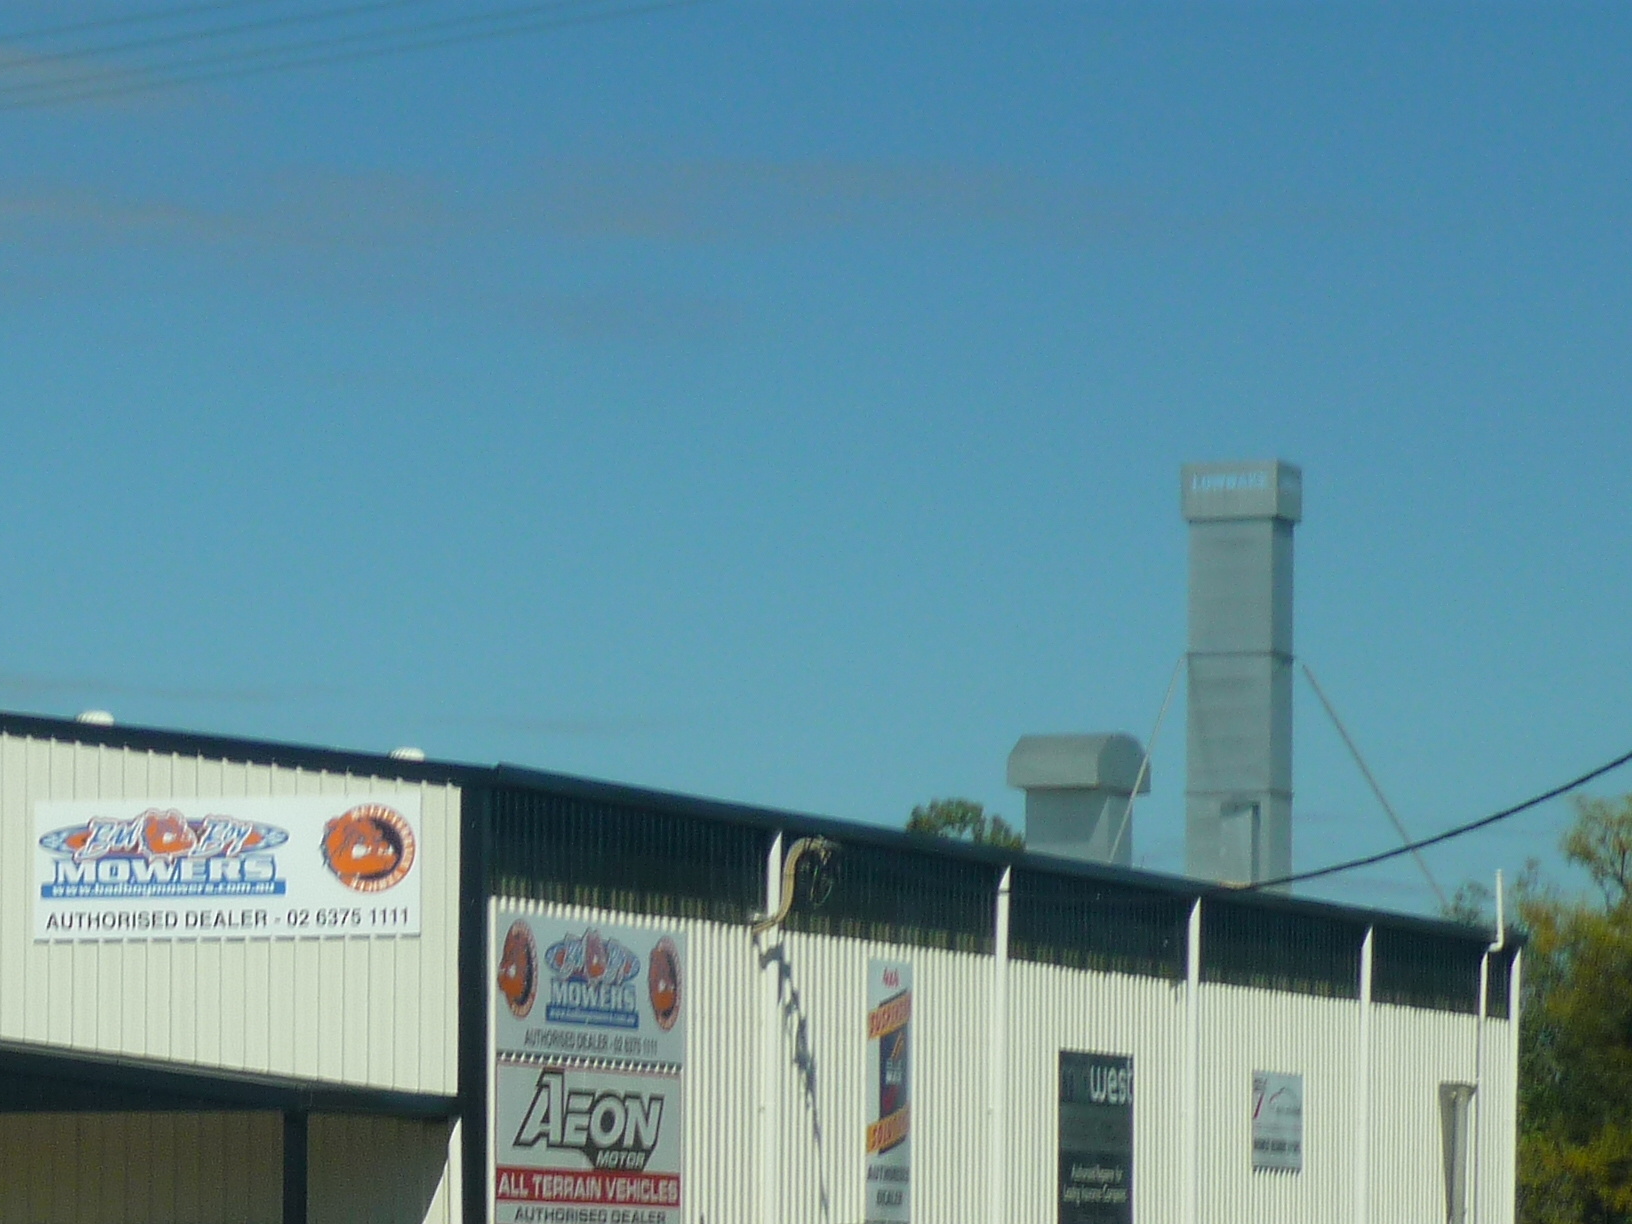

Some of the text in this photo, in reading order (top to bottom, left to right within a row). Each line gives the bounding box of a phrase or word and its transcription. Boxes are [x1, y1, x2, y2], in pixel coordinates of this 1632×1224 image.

[55, 854, 277, 884] MOWERS
[46, 911, 177, 930] AUTHORISED
[185, 910, 267, 929] DEALER
[287, 910, 309, 926] 02
[316, 909, 362, 926] 6375
[371, 907, 409, 925] 1111
[551, 979, 637, 1012] MOWERS
[513, 1068, 665, 1149] AEON
[596, 1152, 645, 1168] MOTOR
[499, 1172, 678, 1203] ALL TERRAIN VEHICLES
[515, 1206, 666, 1224] AUTHORISED DEALER
